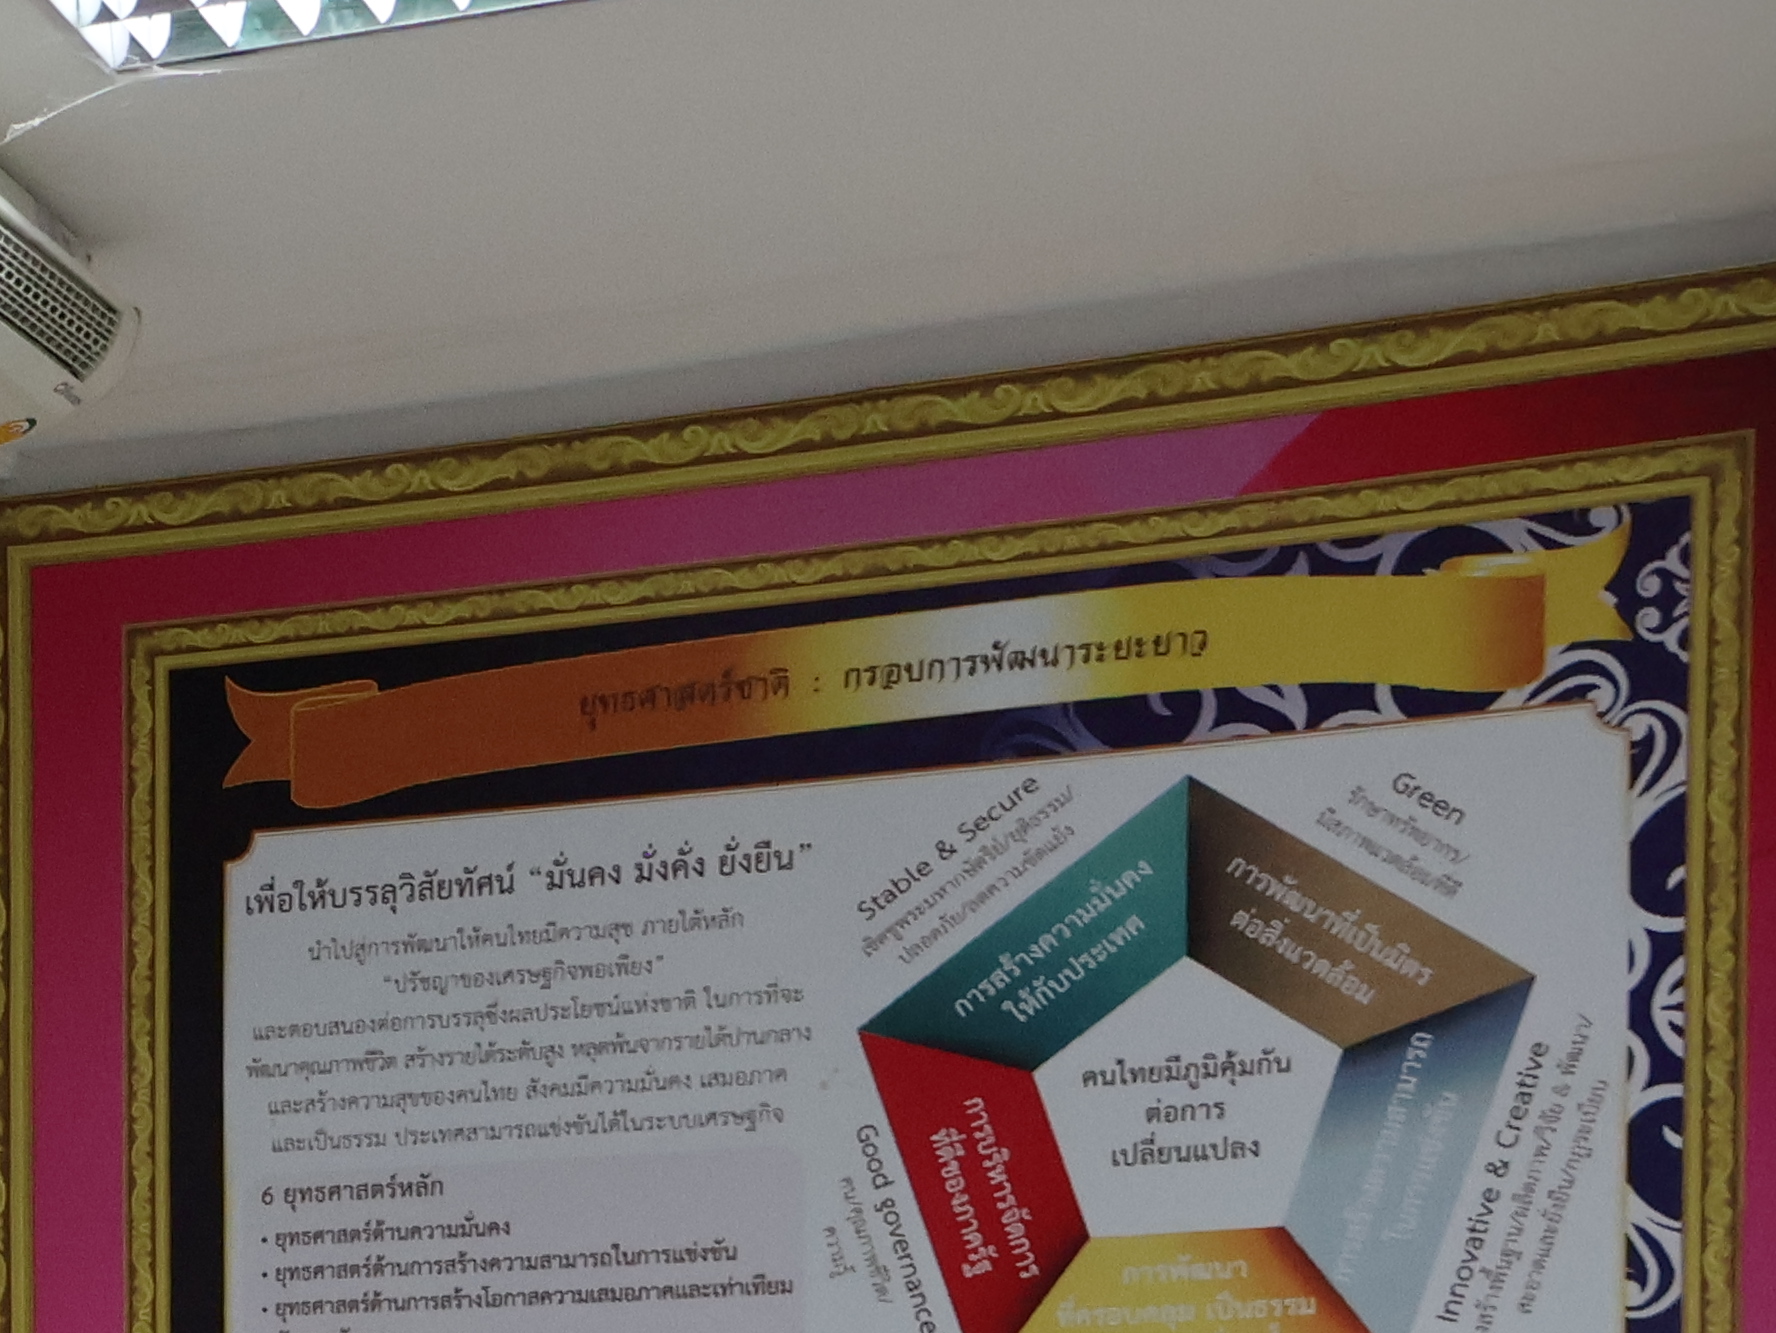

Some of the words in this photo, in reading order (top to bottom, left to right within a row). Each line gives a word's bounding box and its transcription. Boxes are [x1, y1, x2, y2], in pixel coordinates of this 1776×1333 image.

[842, 627, 1209, 695] กรอบการพัฒนาระยะยาว
[1391, 771, 1468, 827] Green
[245, 860, 516, 916] เพื่อให้บรรลุวิสัยทัศน์
[634, 840, 705, 886] มั่งคั่ง
[856, 857, 935, 922] Stable
[934, 839, 959, 862] &
[957, 775, 1040, 844] Secure
[1081, 1047, 1292, 1090] คนไทยมีภูมิคุ้มกัน
[1145, 1099, 1227, 1125] ต่อการ
[856, 1123, 895, 1192] Good
[1111, 1136, 1262, 1168] เปลี่ยนแปลง
[1435, 1186, 1502, 1324] Innovative
[1494, 1040, 1551, 1150] Creative
[261, 1186, 274, 1206] 6
[284, 1174, 445, 1212] ยุทธศาสตร์หลัก
